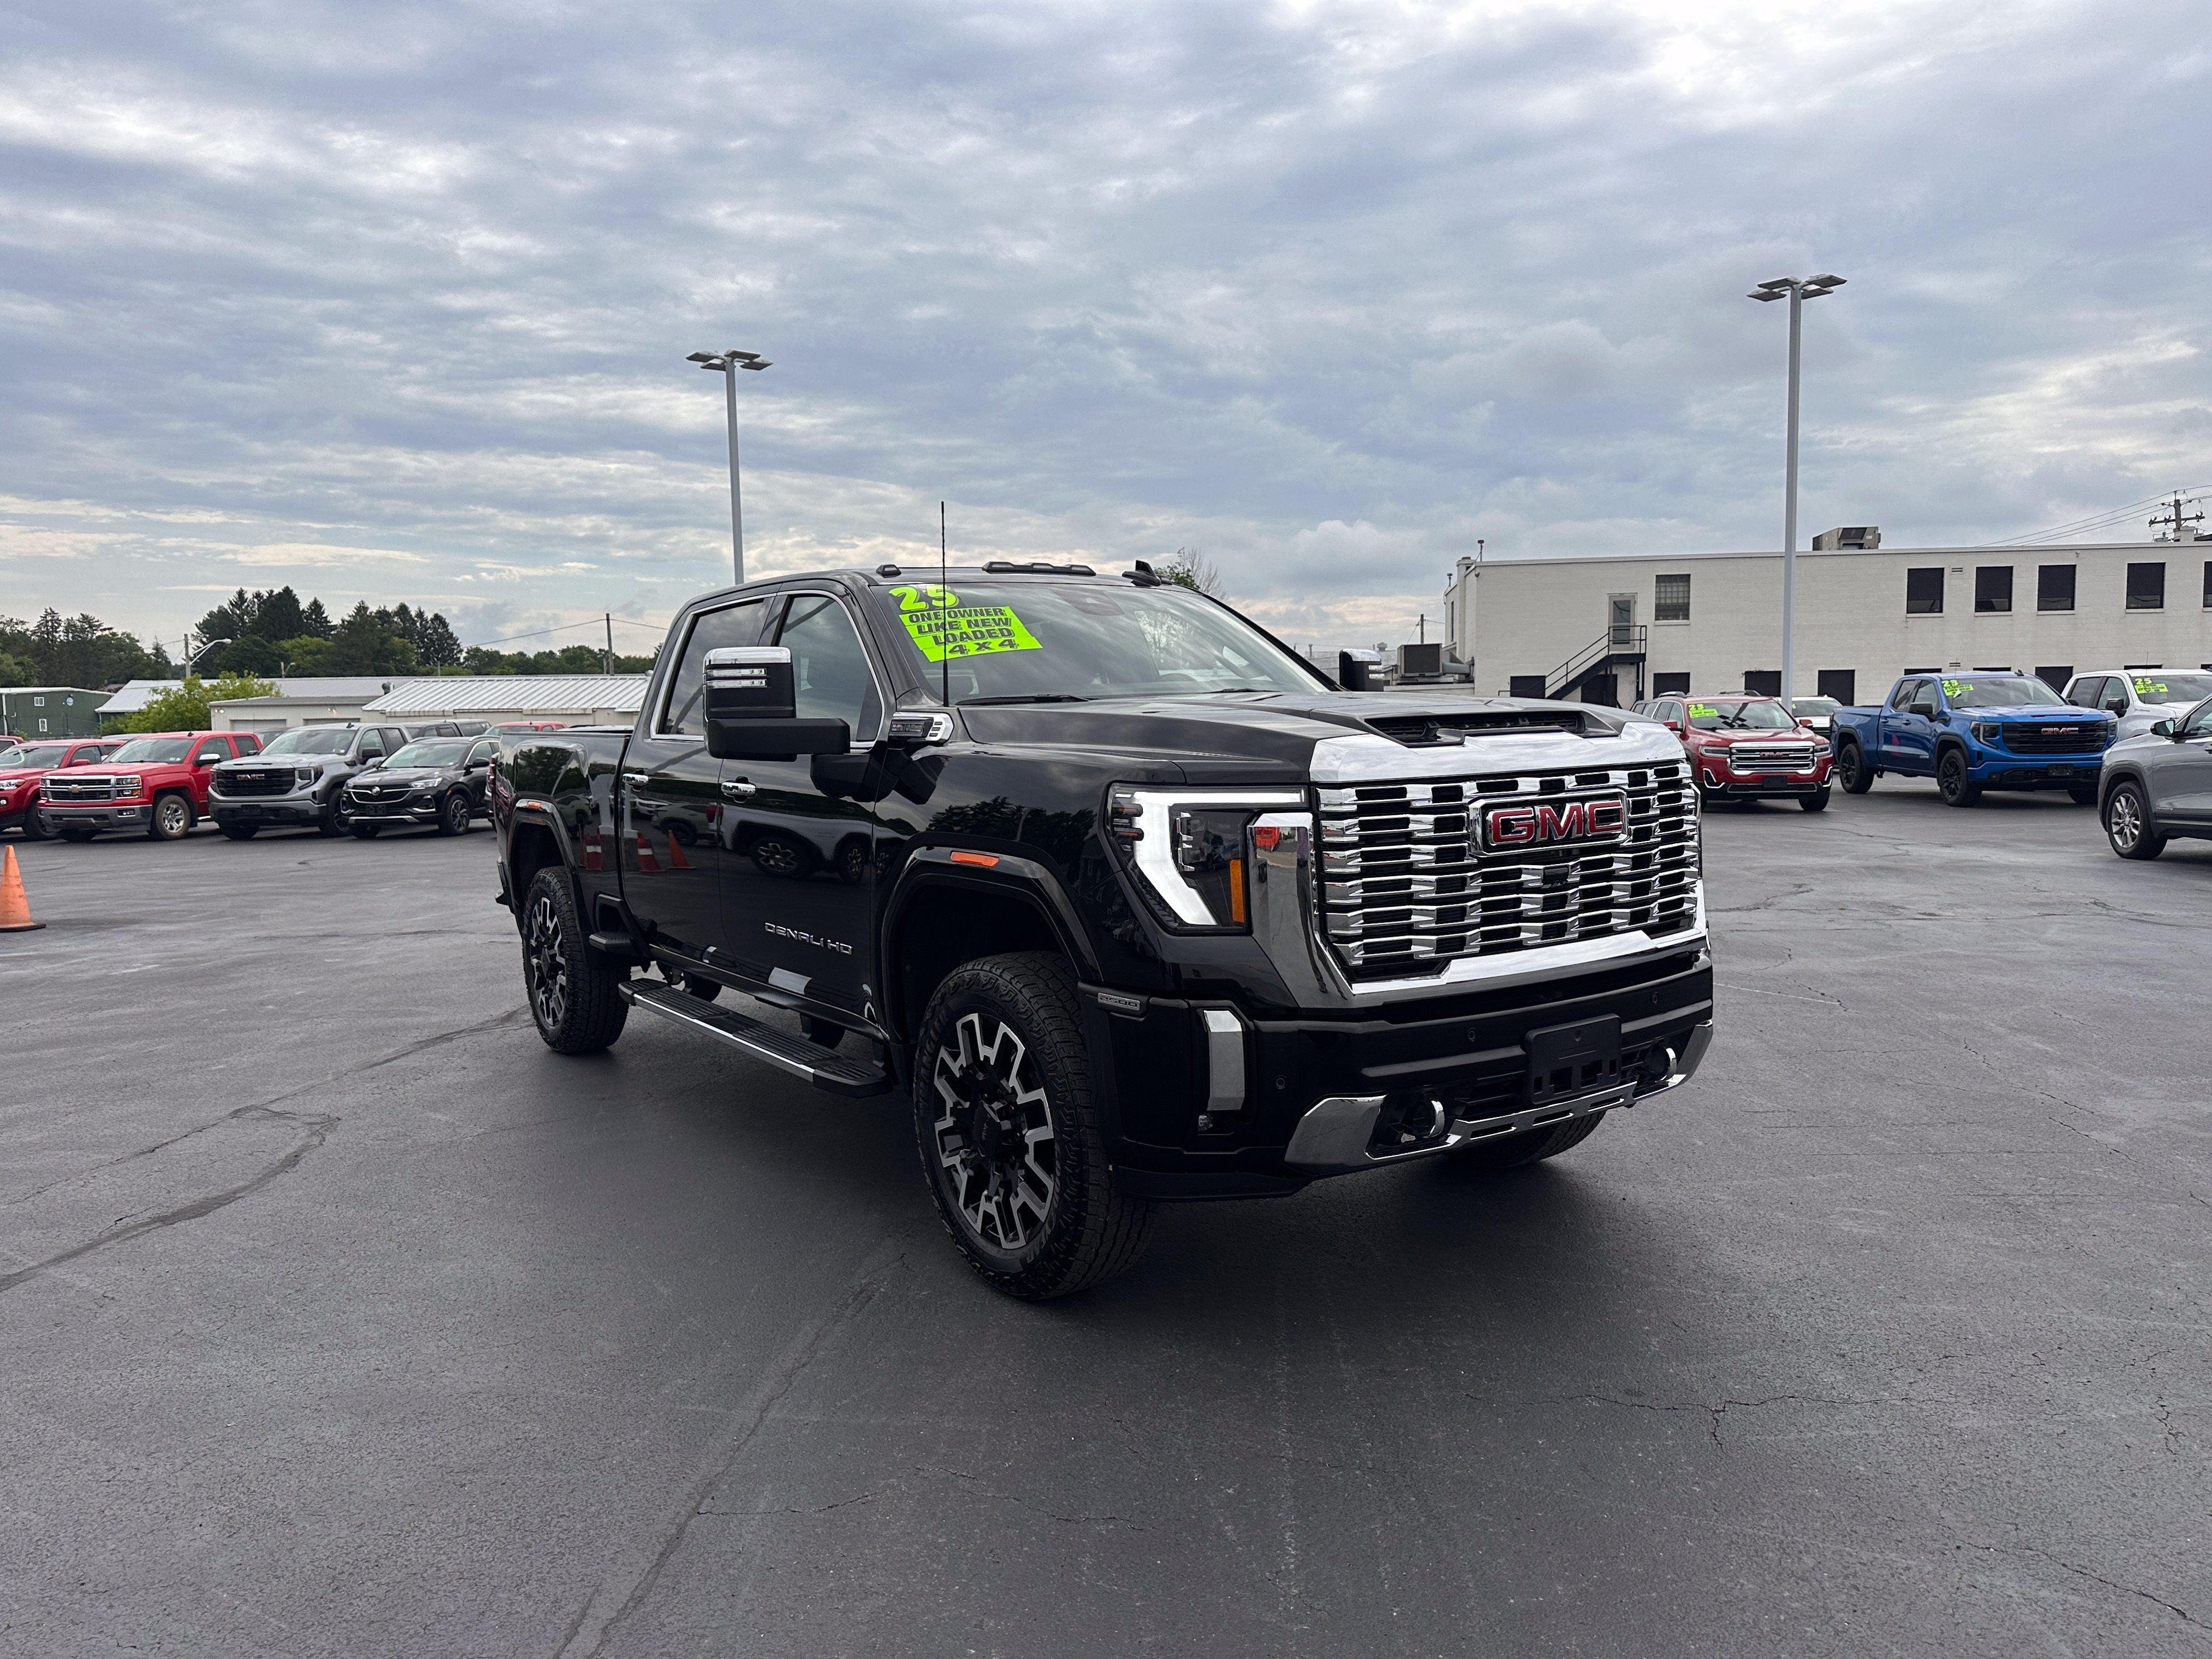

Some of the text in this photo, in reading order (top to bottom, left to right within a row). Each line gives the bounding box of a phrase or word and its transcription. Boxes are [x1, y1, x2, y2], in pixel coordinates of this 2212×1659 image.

[889, 584, 959, 612] 25
[909, 608, 1007, 623] ONE OWNER
[916, 618, 1012, 635] LIKE NEW
[933, 628, 1015, 646] LOADED
[1487, 799, 1623, 845] GMC
[764, 922, 852, 955] DENALI HD
